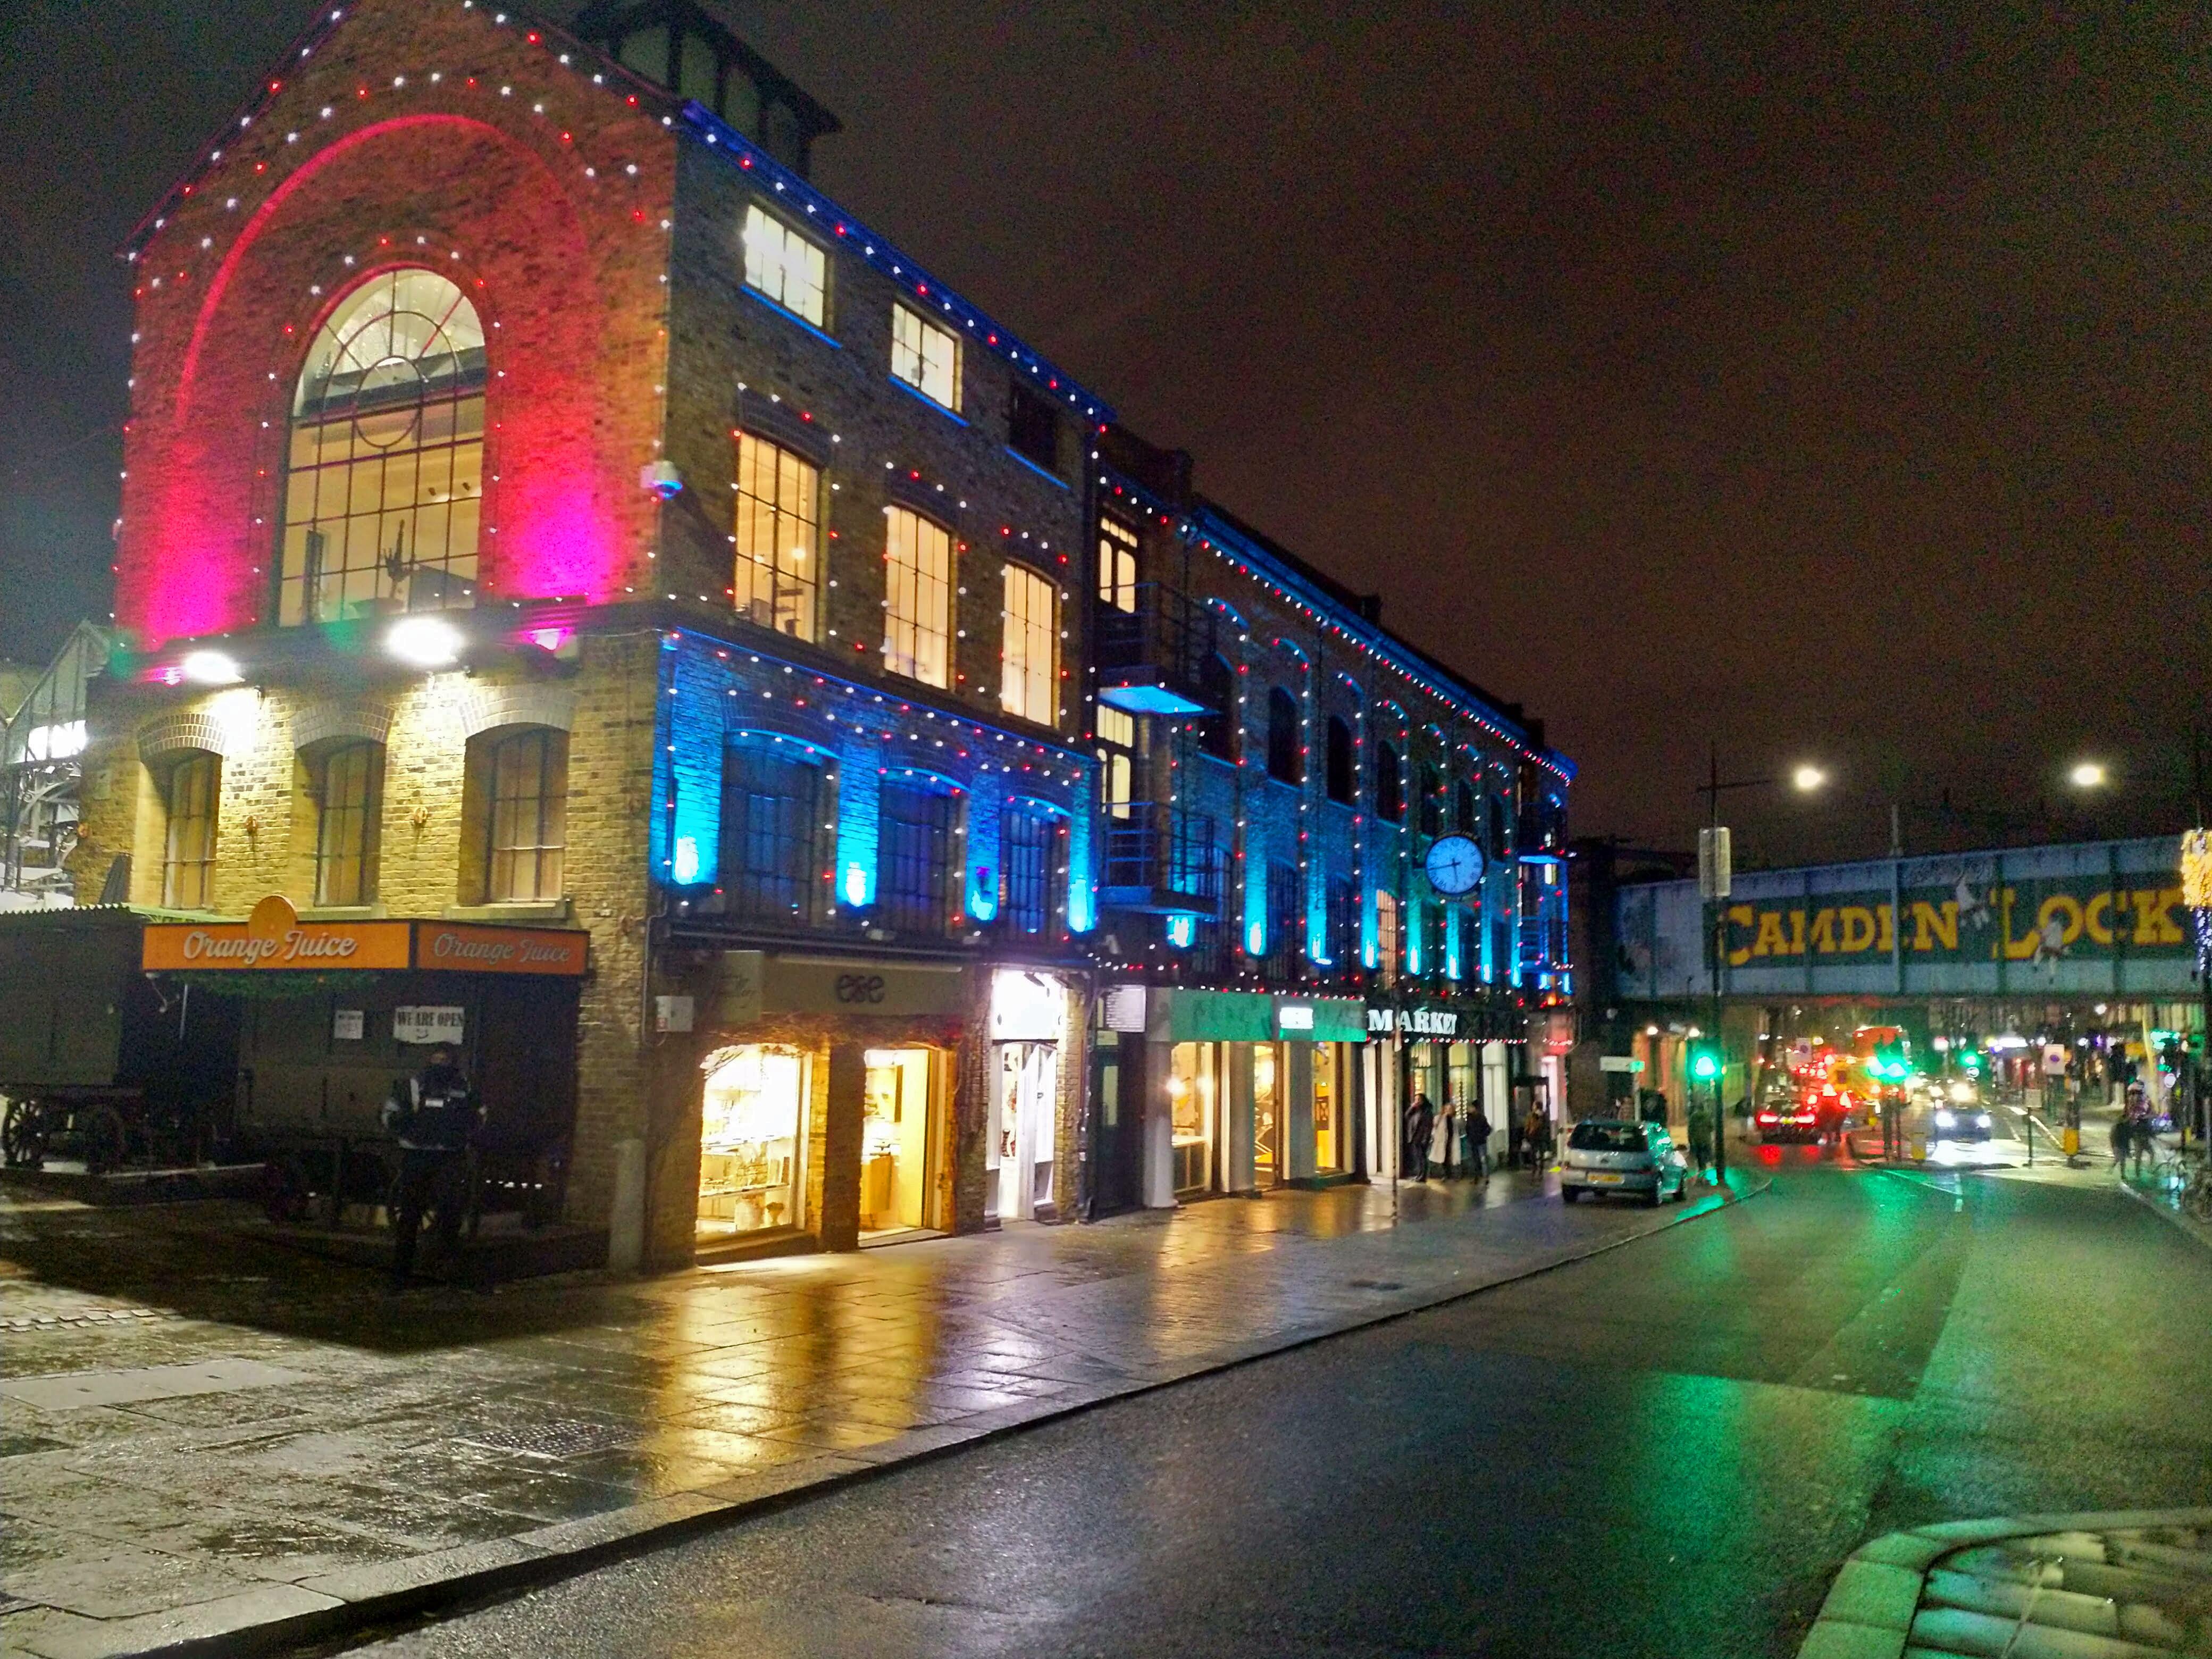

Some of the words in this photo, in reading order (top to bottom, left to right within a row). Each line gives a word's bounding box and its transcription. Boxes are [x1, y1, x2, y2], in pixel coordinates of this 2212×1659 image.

[1717, 901, 1959, 966] CAMDEN
[1990, 887, 2185, 959] LOCK
[183, 931, 278, 965] Orange
[285, 930, 358, 960] Juice
[433, 933, 515, 965] Orange
[519, 939, 570, 963] Juice
[398, 1011, 412, 1026] WE
[415, 1012, 434, 1026] ARE
[1367, 1009, 1457, 1035] MARKET
